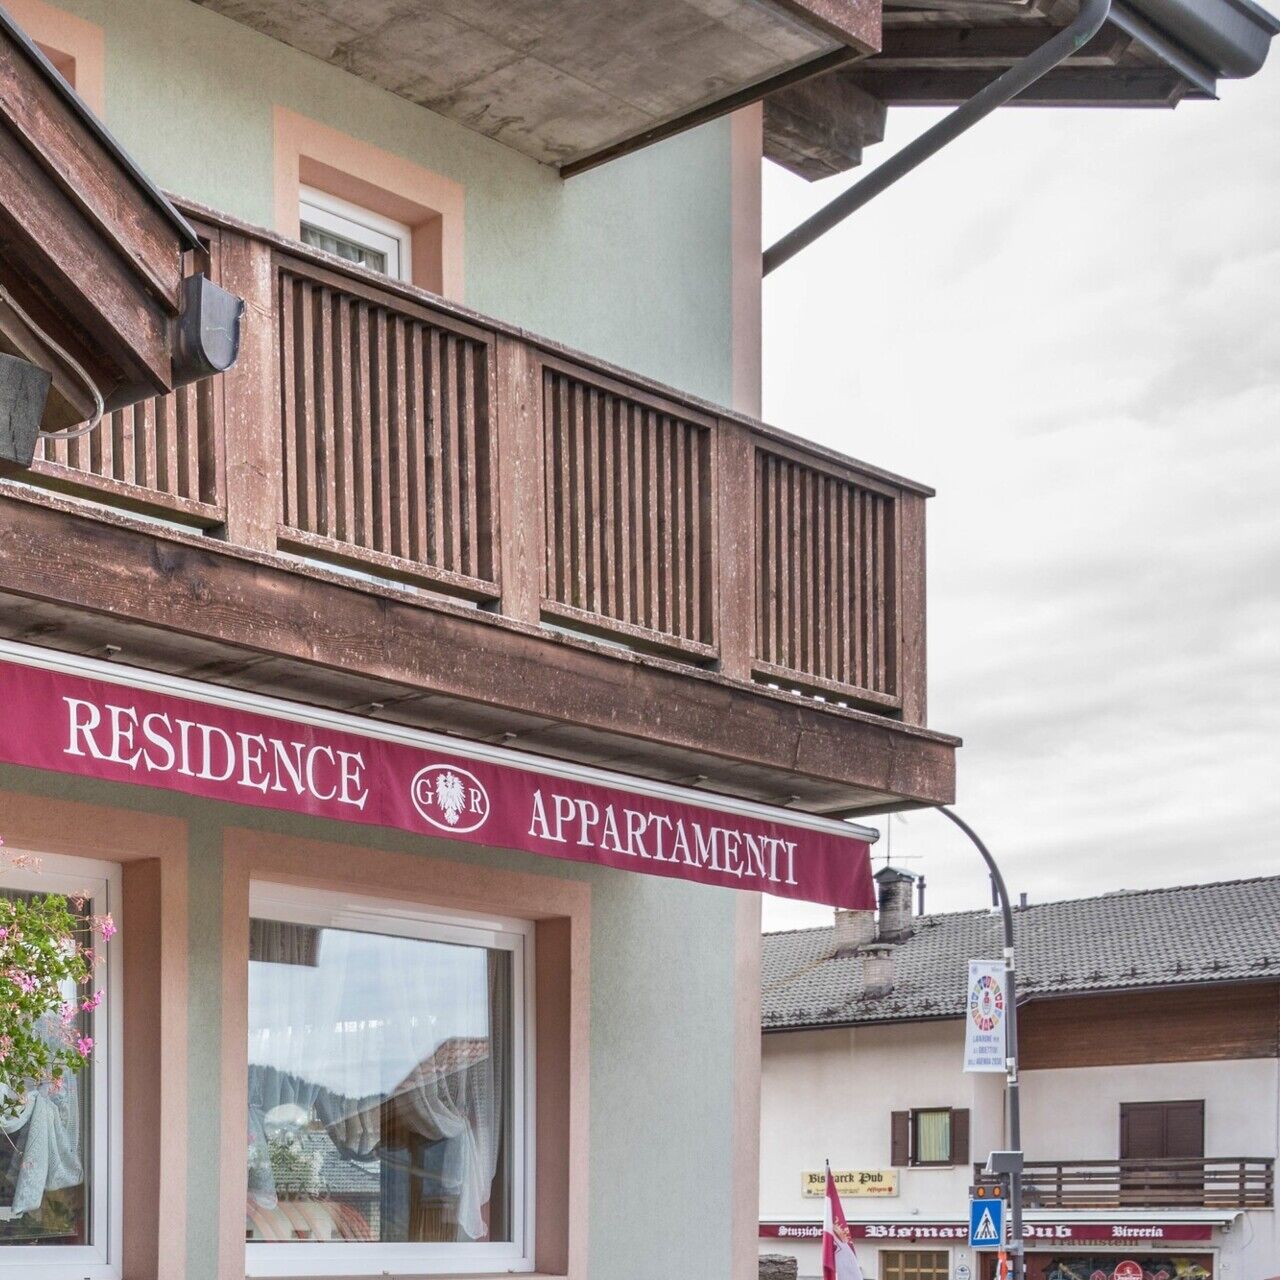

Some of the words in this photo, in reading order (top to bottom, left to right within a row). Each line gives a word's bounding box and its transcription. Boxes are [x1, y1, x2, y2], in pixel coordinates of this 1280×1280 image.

[62, 696, 369, 810] RESIDENCE
[528, 788, 799, 885] APPARTAMENTI
[808, 1173, 855, 1184] Bisarck
[859, 1172, 883, 1184] Pub
[778, 1225, 824, 1238] Stuzziche
[864, 1225, 969, 1238] Bismar
[1112, 1225, 1164, 1238] Birreria
